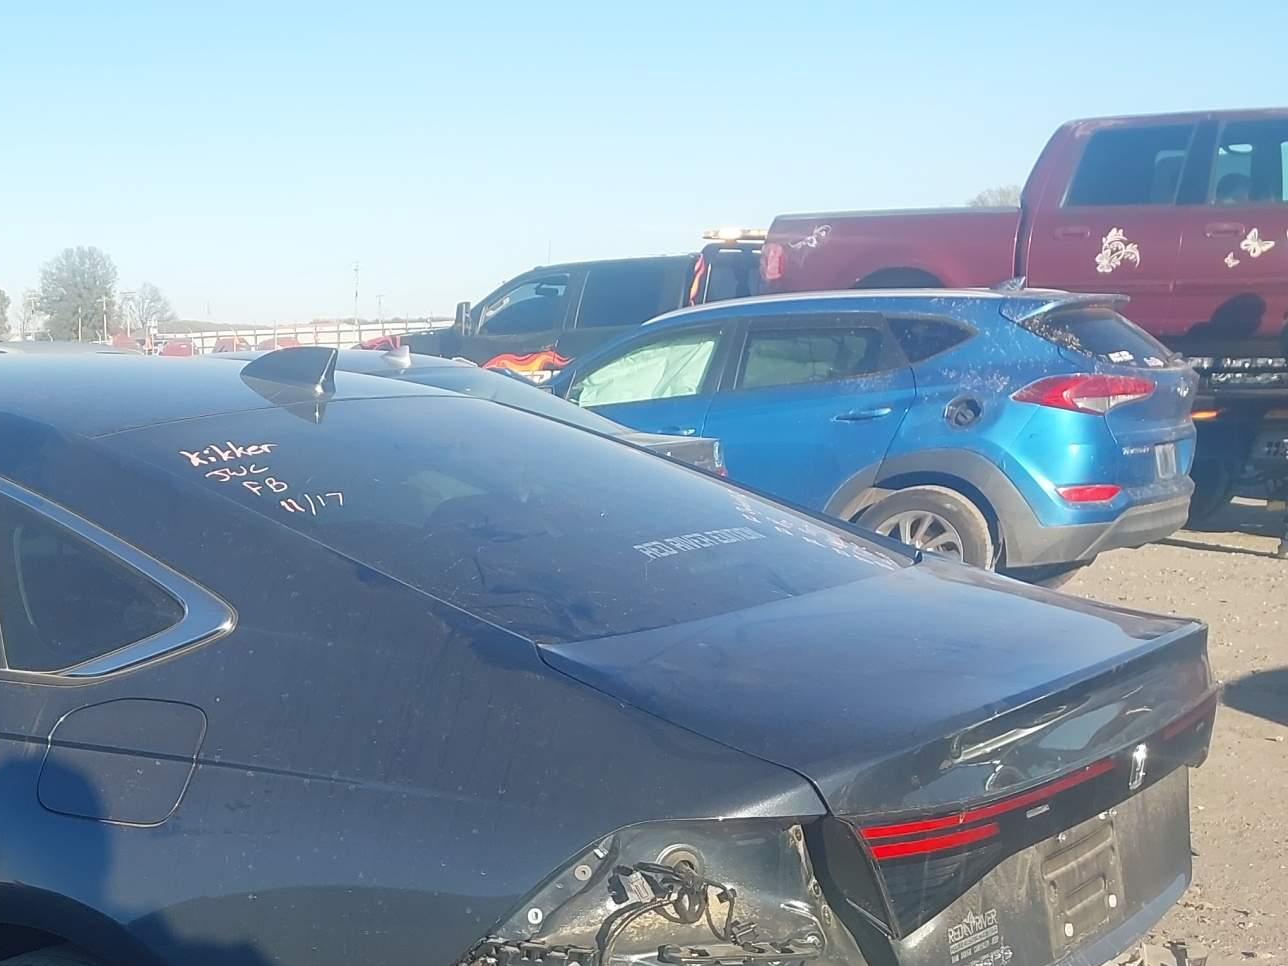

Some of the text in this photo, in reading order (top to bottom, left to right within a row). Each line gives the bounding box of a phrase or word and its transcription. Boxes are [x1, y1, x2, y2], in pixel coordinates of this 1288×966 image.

[279, 492, 344, 516] 11/17
[632, 540, 679, 559] RED
[664, 533, 719, 552] RIVER
[947, 924, 964, 944] RED
[975, 908, 999, 932] RIVER
